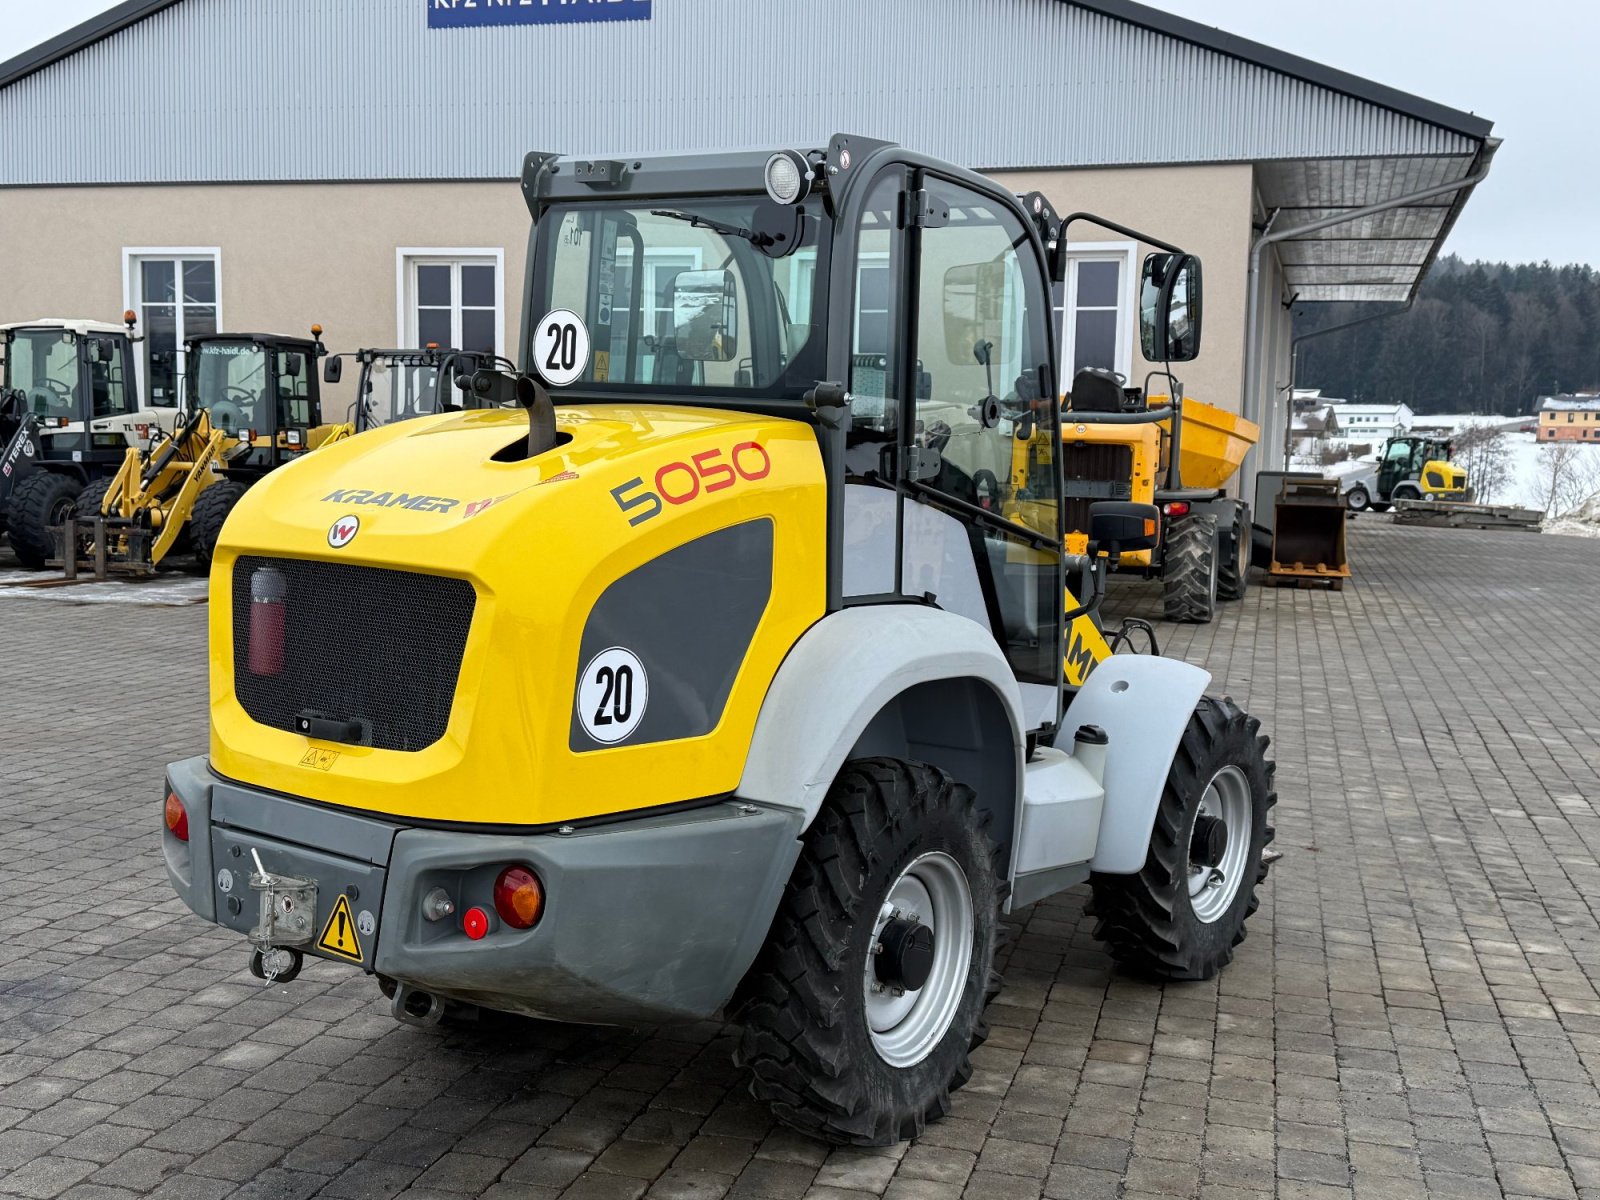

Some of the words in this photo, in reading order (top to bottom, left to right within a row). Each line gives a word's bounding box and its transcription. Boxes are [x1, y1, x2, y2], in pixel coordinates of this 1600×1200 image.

[546, 323, 577, 370] 20
[8, 426, 29, 463] TEREX
[193, 445, 216, 482] YANMAR
[320, 489, 460, 513] KRAMER
[609, 441, 771, 527] 5050
[593, 664, 633, 726] 20
